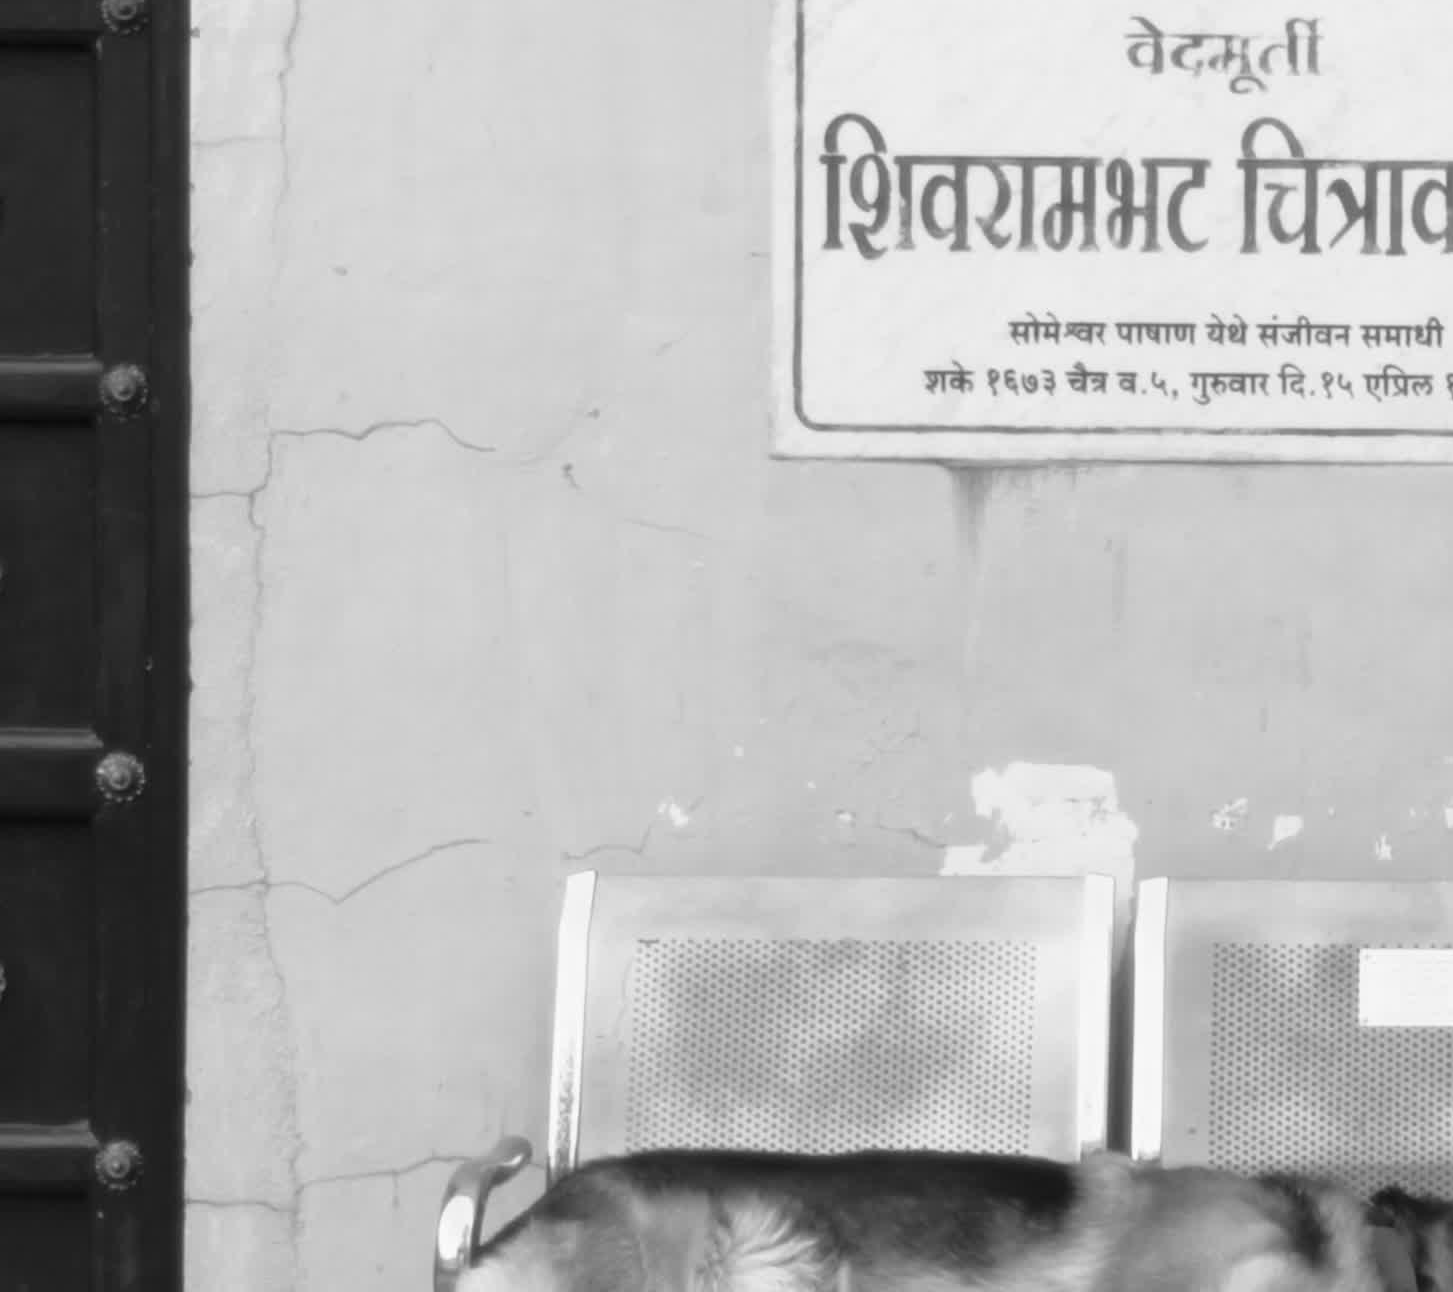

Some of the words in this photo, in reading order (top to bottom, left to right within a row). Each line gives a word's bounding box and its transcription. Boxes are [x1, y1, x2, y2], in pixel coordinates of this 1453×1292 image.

[819, 113, 1211, 260] शिवरामभट
[1008, 312, 1107, 344] सोमेश्वर
[1115, 322, 1196, 345] पाषाण
[1205, 314, 1248, 345] येथे
[1256, 316, 1351, 346] संजीवन
[1360, 317, 1444, 348] समाधी
[924, 361, 974, 393] शके
[987, 369, 1056, 396] १६७३
[1065, 362, 1109, 393] चैत्र
[1189, 372, 1270, 405] गुरुवार
[1363, 364, 1433, 402] एप्रिल
